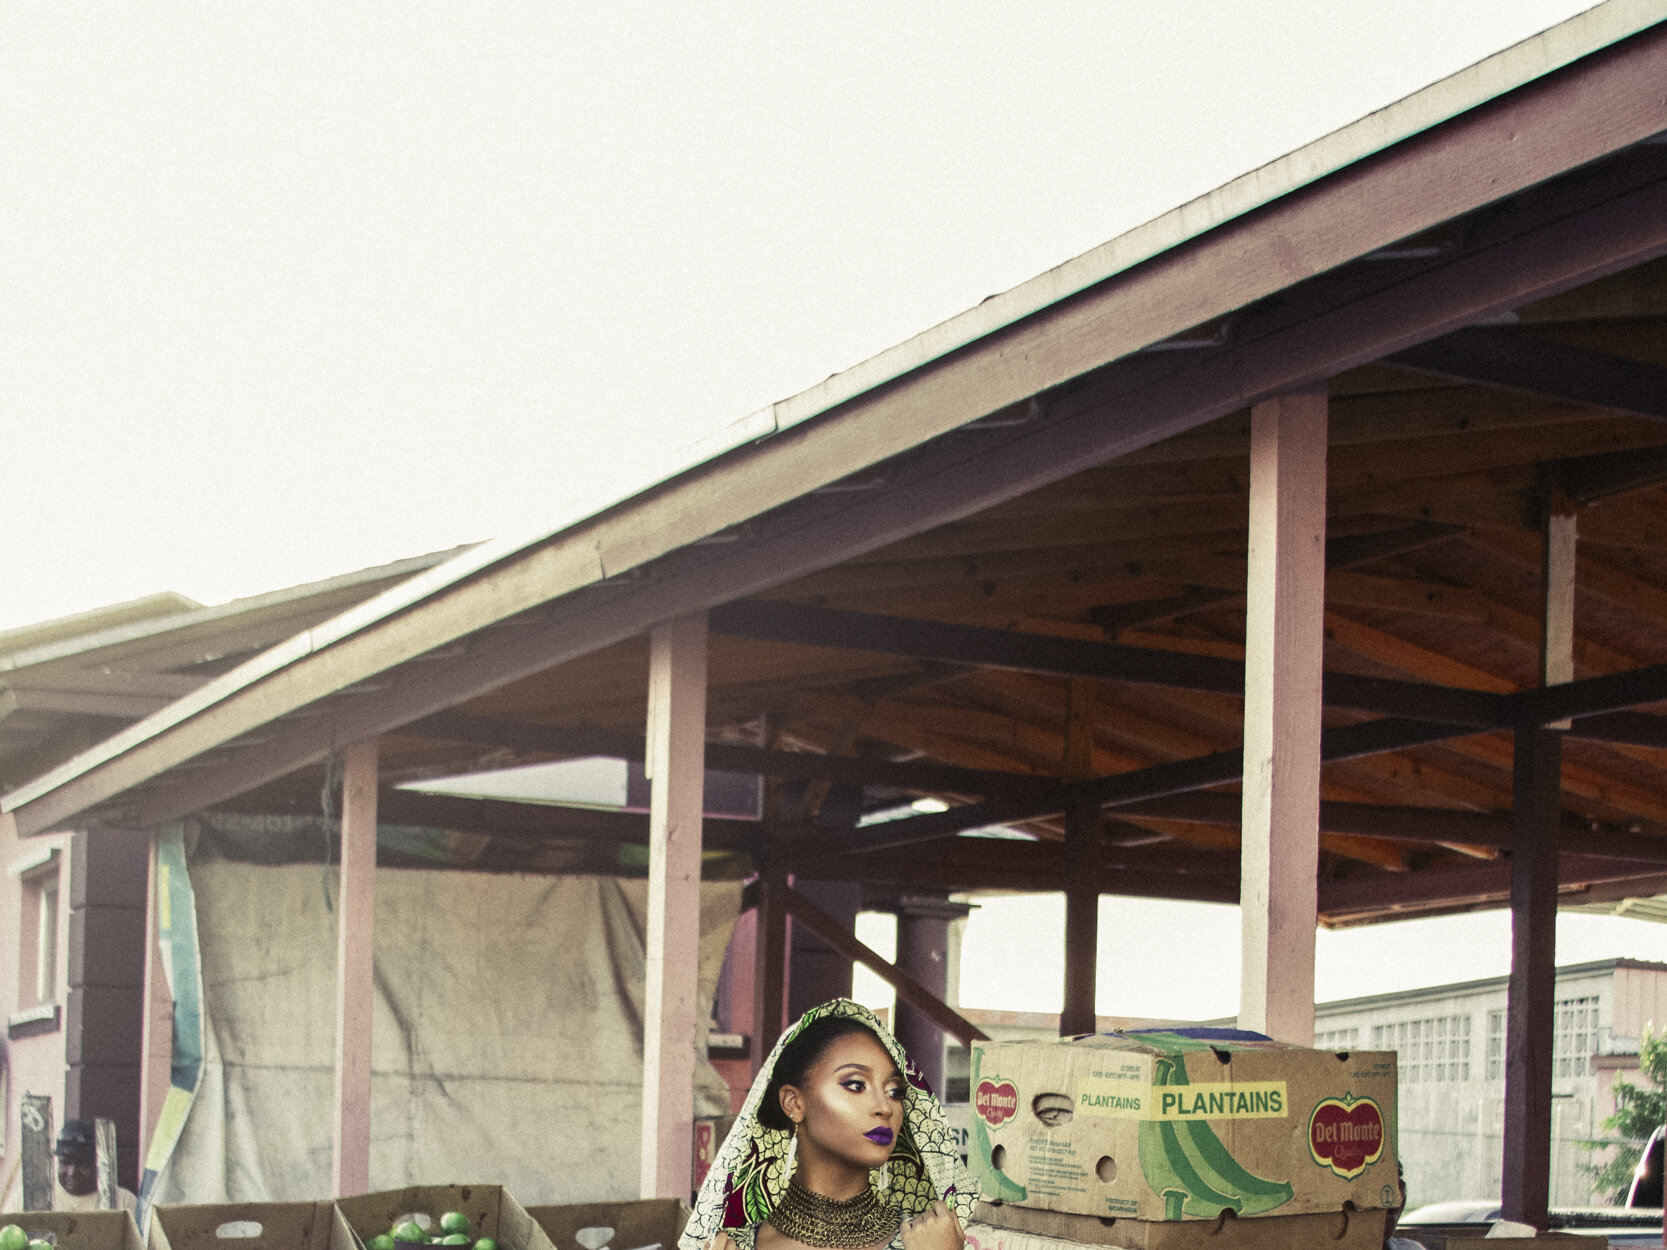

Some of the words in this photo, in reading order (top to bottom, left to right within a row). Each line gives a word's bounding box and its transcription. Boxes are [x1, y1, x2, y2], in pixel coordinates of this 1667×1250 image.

[977, 1092, 990, 1106] Del
[991, 1093, 1016, 1109] Monte
[1081, 1093, 1141, 1111] PLANTAINS
[1161, 1090, 1283, 1115] PLANTAINS
[1315, 1122, 1337, 1143] Del
[1340, 1121, 1380, 1141] Monte
